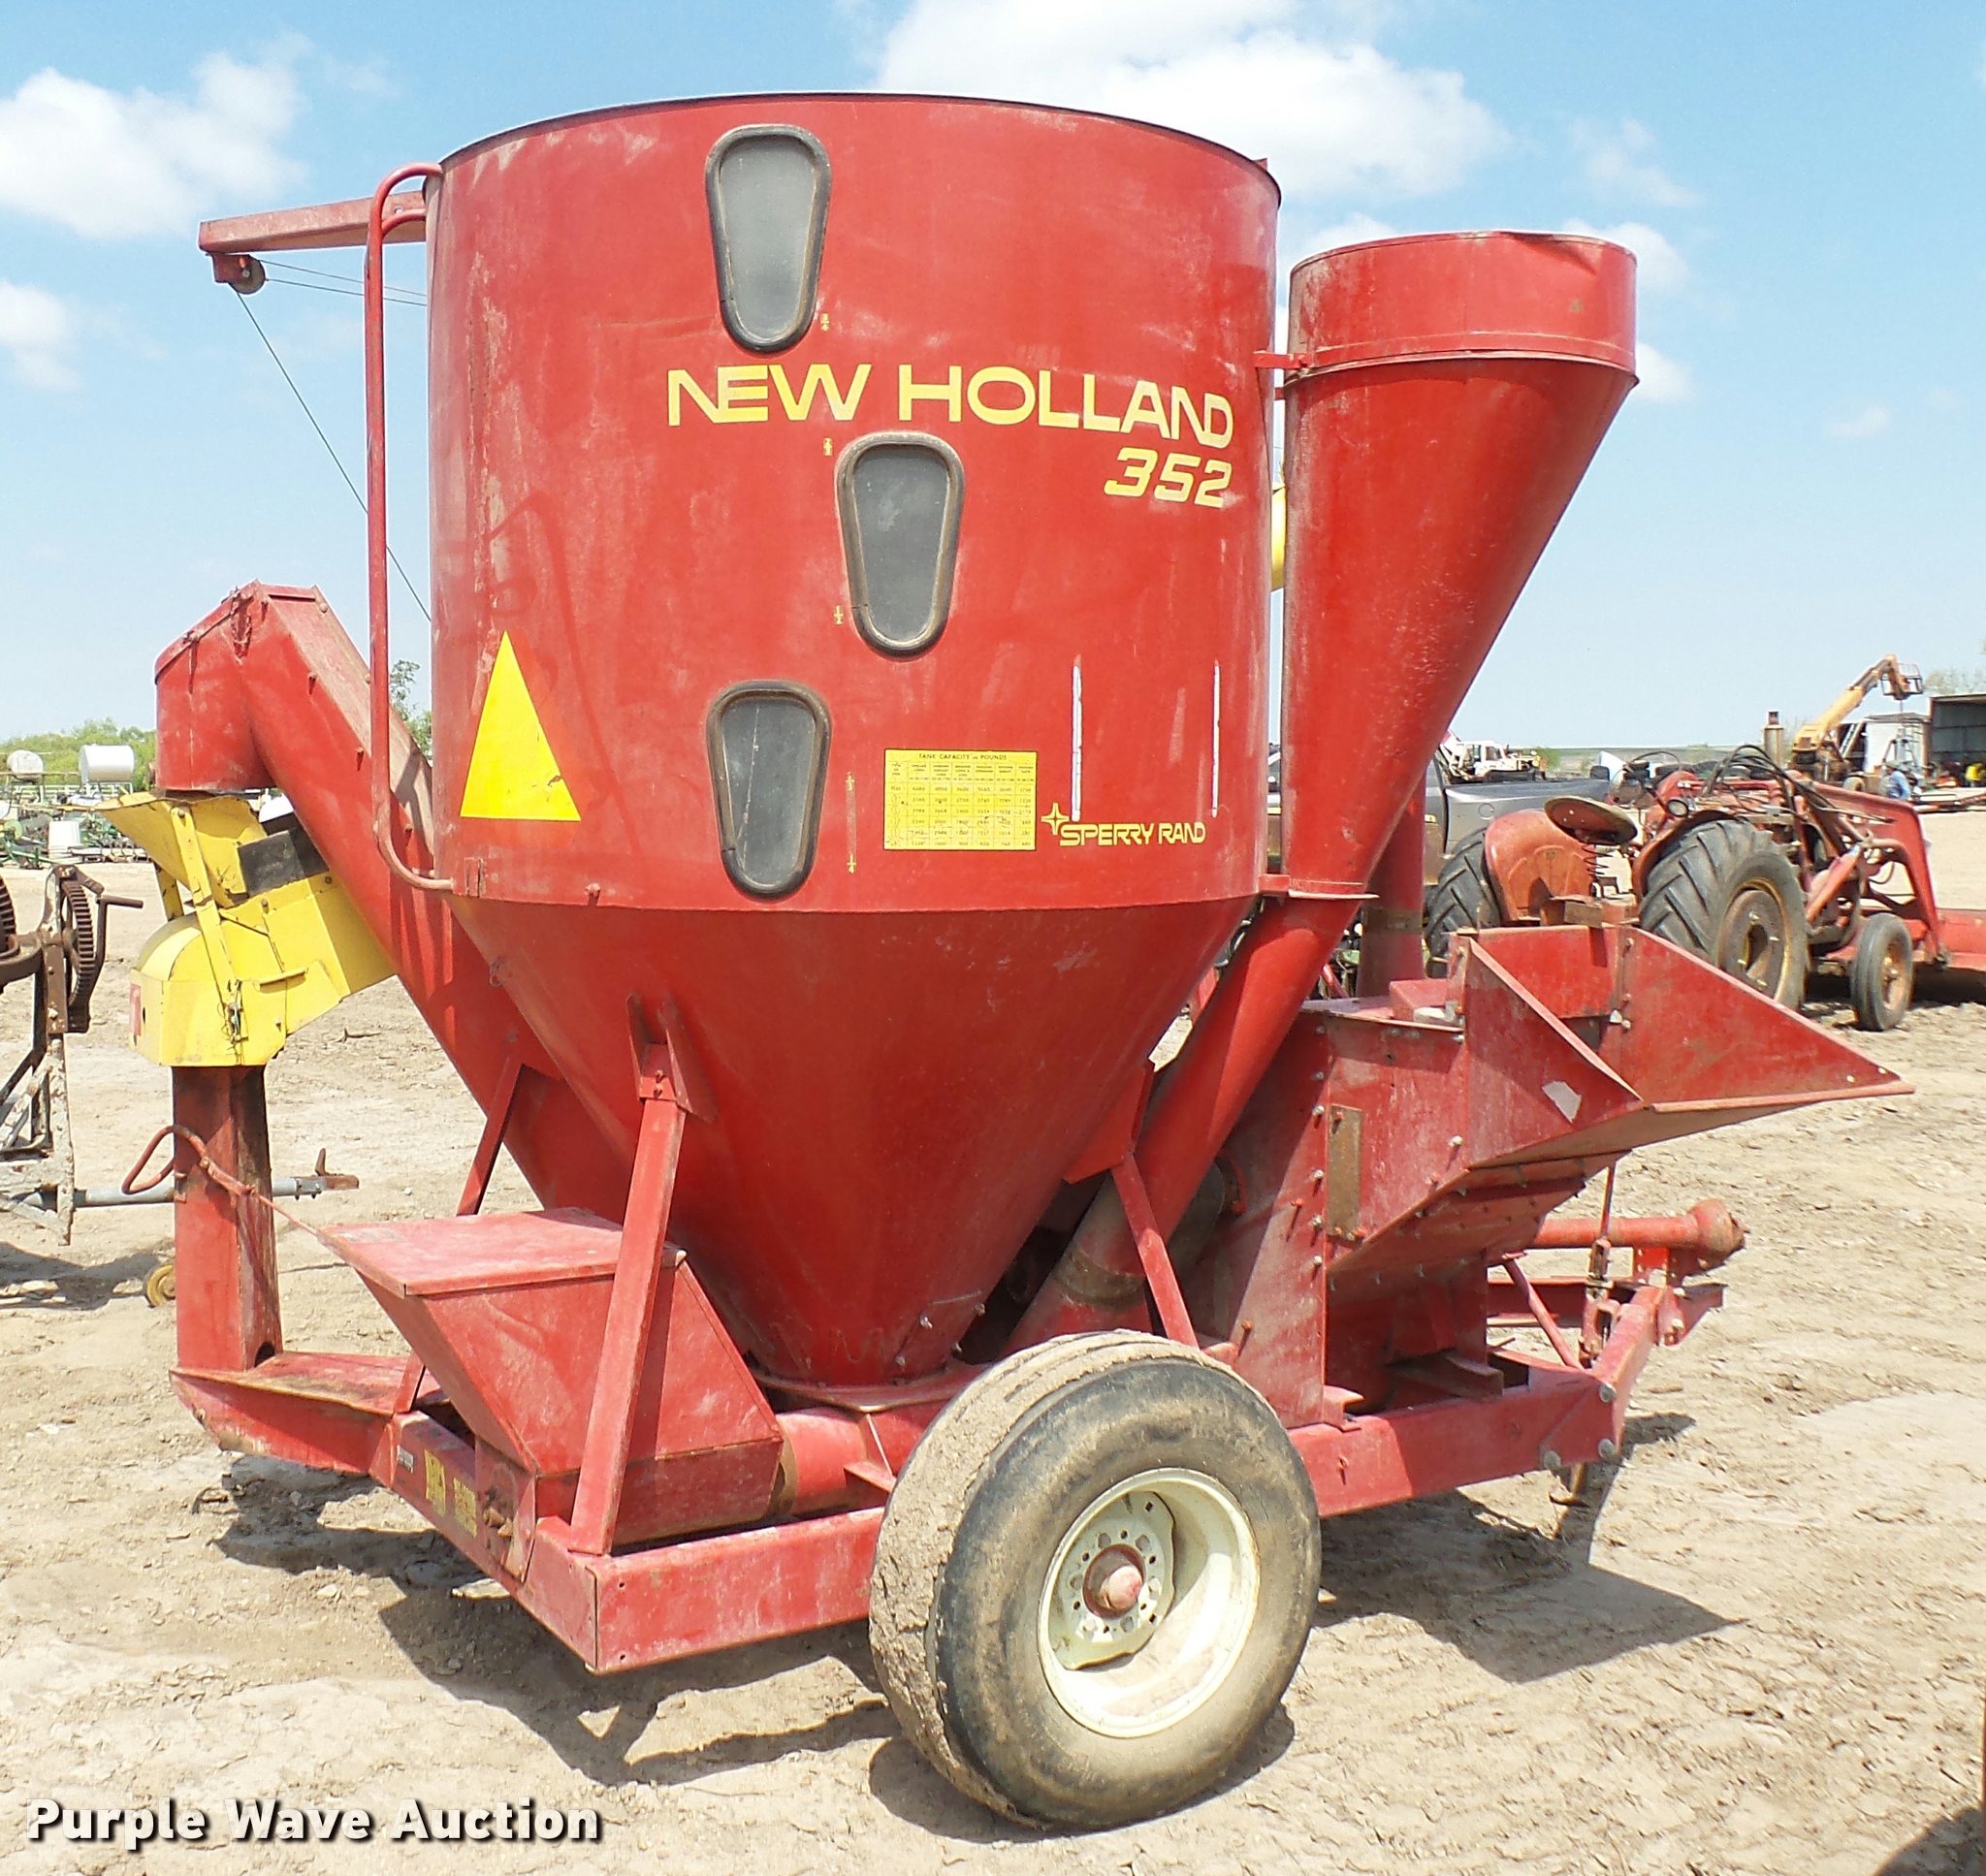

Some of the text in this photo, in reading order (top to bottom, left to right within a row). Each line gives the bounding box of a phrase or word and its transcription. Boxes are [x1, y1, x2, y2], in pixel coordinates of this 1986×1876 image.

[668, 364, 1234, 449] NEW HOLLAND
[1103, 447, 1233, 509] 352
[1059, 821, 1207, 846] SPERRY RAND
